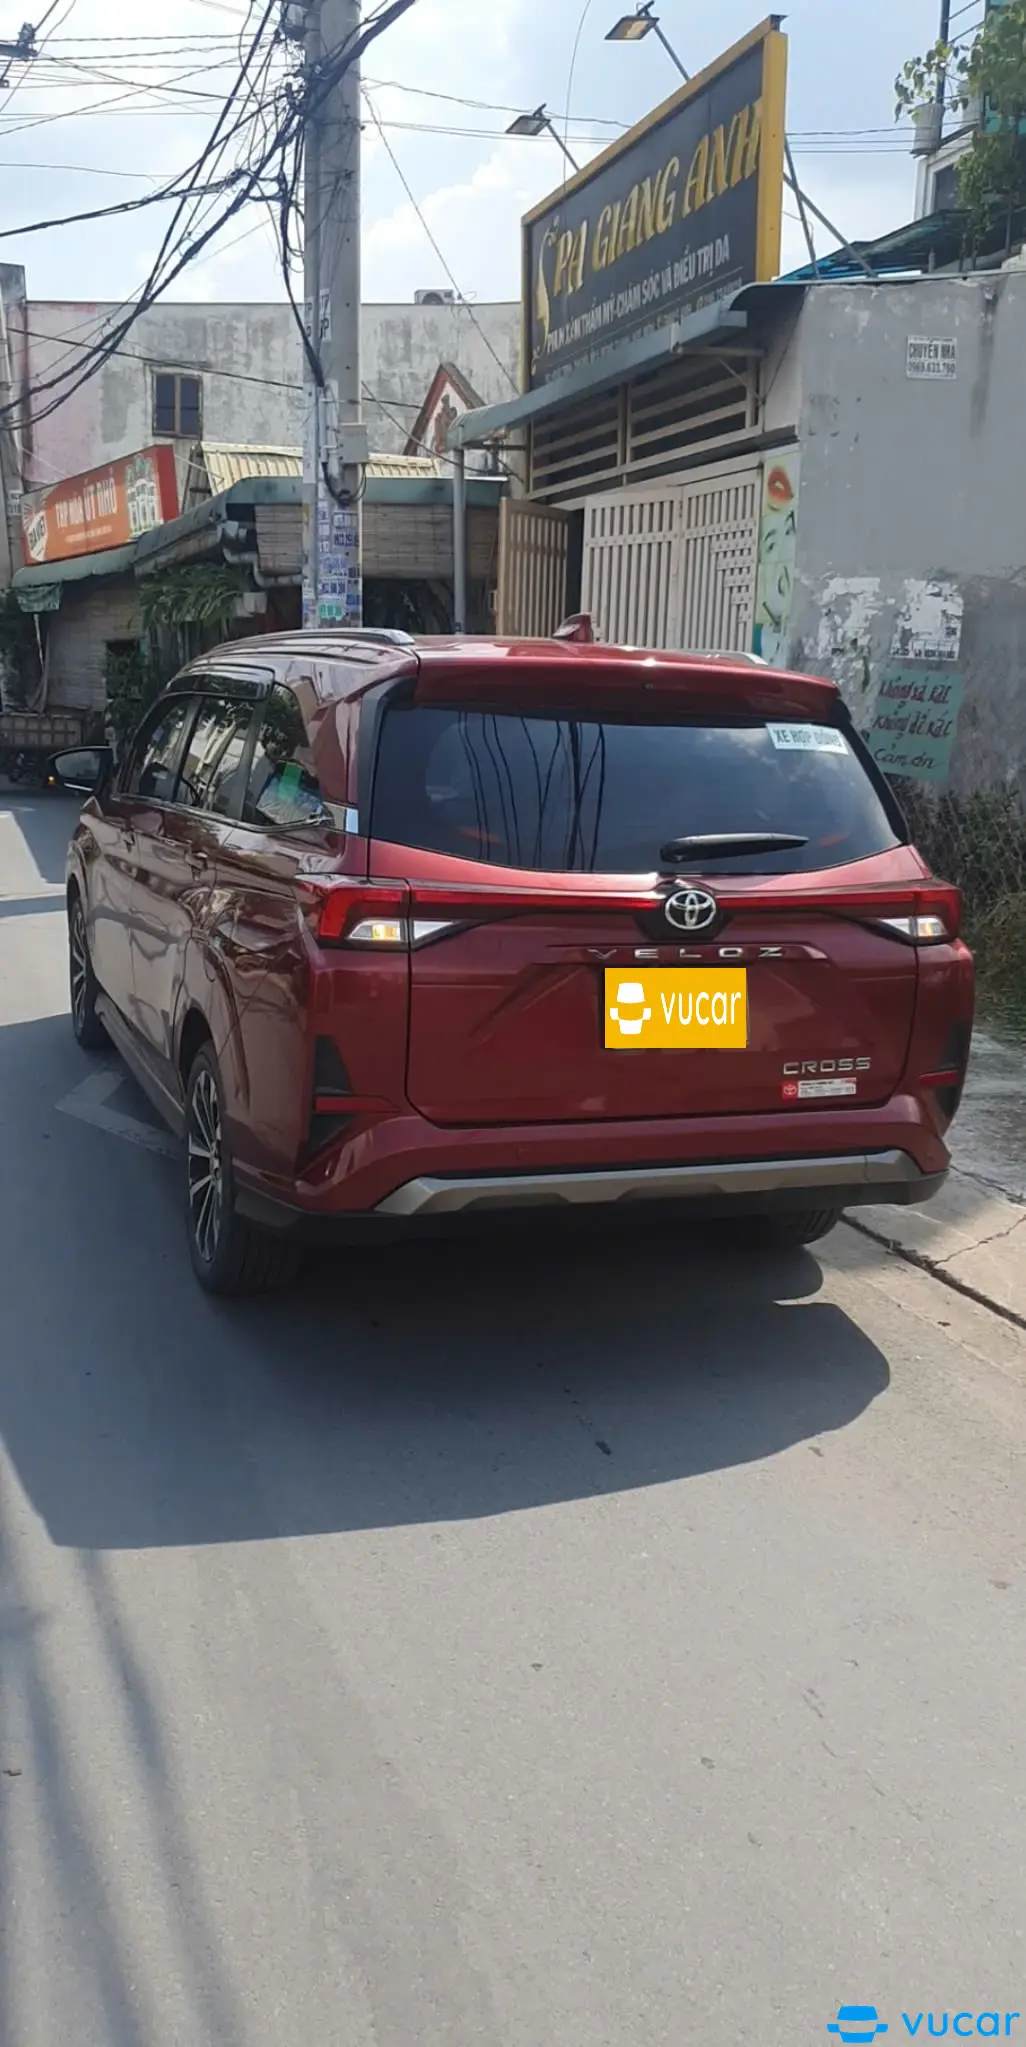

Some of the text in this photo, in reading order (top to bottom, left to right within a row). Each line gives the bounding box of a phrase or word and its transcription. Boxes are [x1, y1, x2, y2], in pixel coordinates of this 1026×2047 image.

[592, 156, 681, 272] GIANG
[682, 96, 763, 218] ANH
[697, 242, 714, 277] TRỊ
[715, 234, 730, 268] DA
[588, 947, 783, 959] VELOZ
[783, 1057, 871, 1075] CROSS
